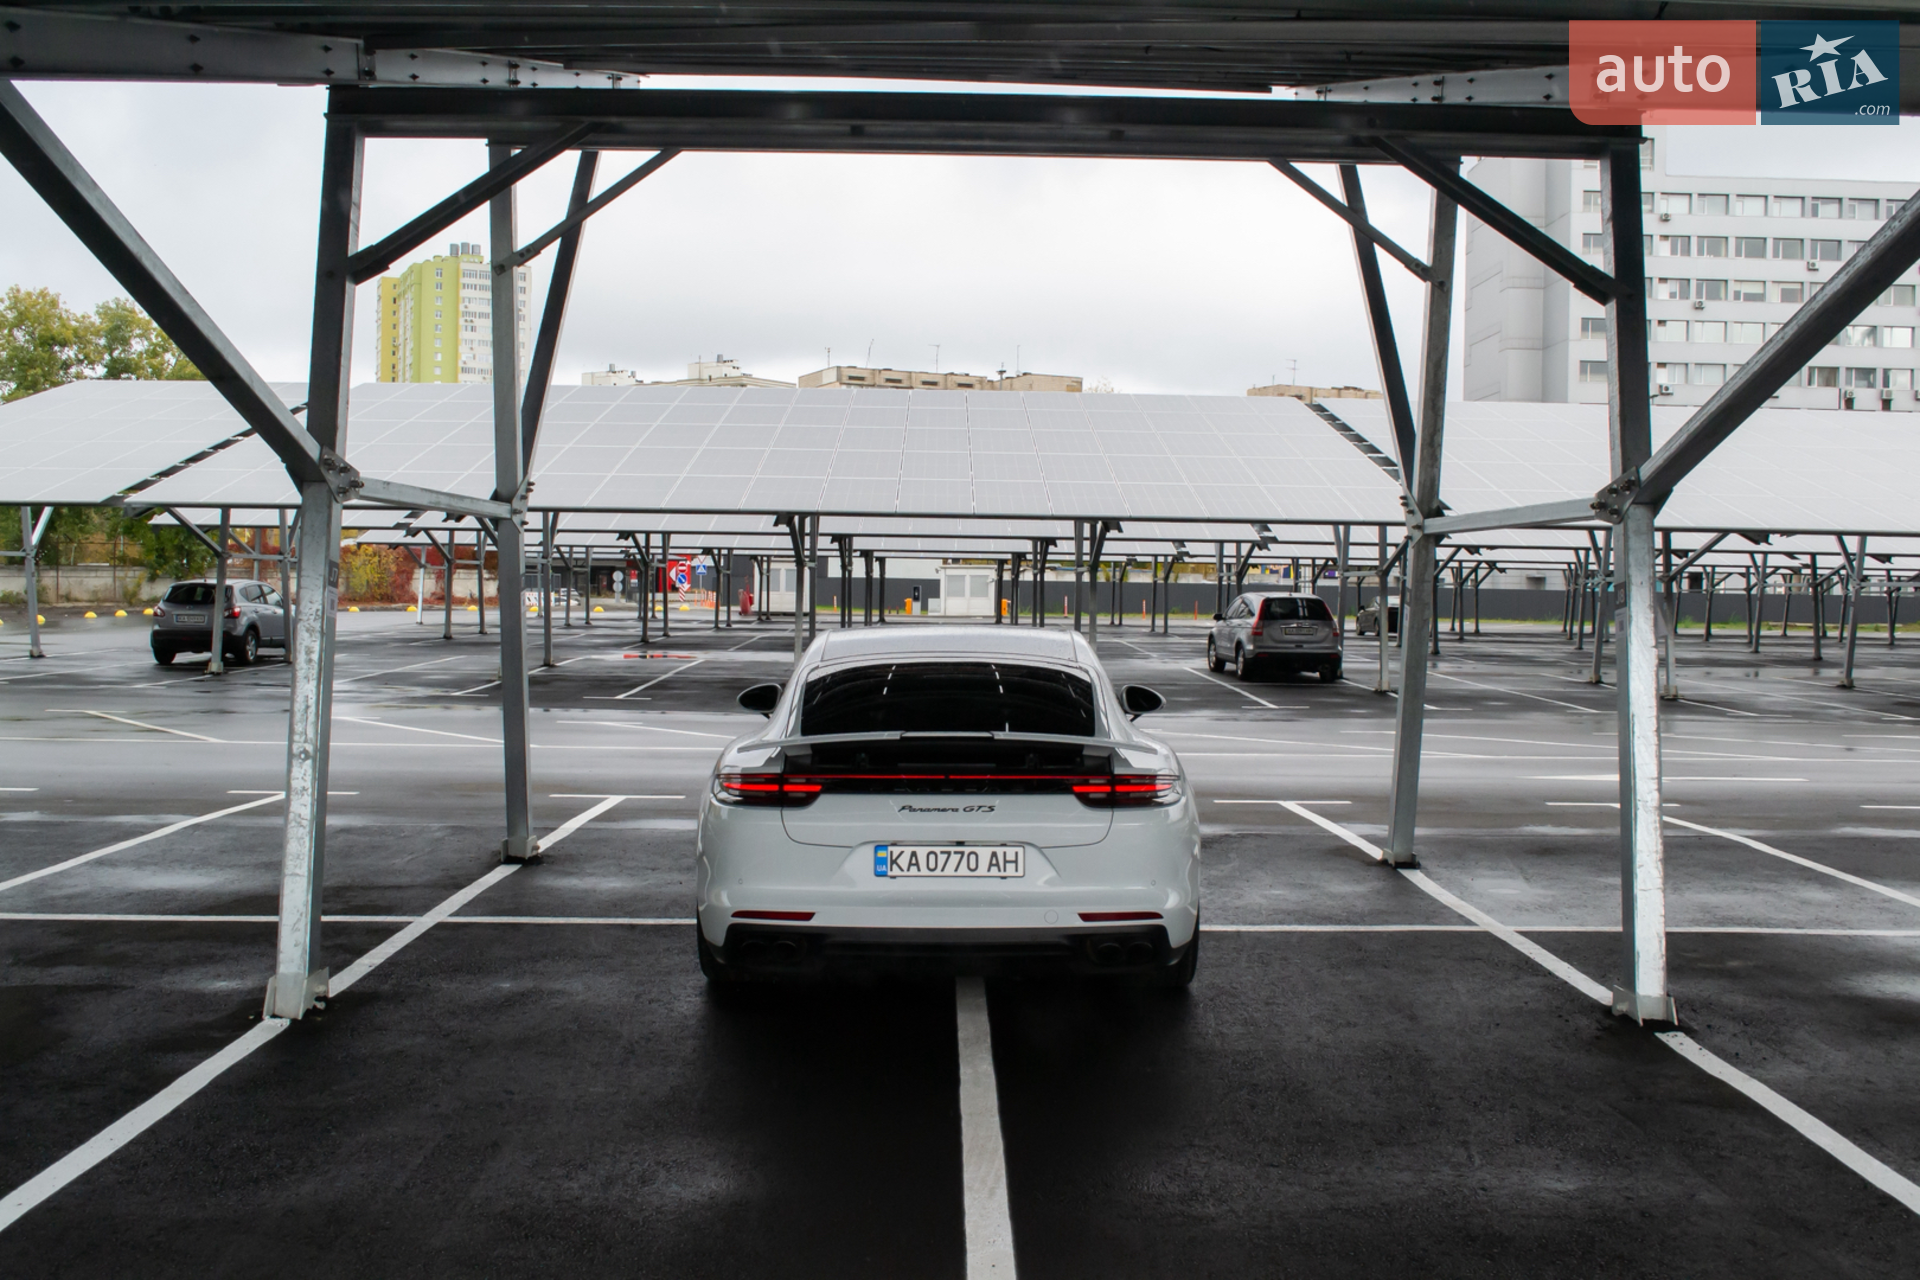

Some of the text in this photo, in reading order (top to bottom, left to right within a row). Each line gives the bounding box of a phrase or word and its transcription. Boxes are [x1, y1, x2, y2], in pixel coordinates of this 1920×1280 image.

[898, 804, 996, 813] Panamera GTS
[889, 850, 1019, 873] KA 0770 AH
